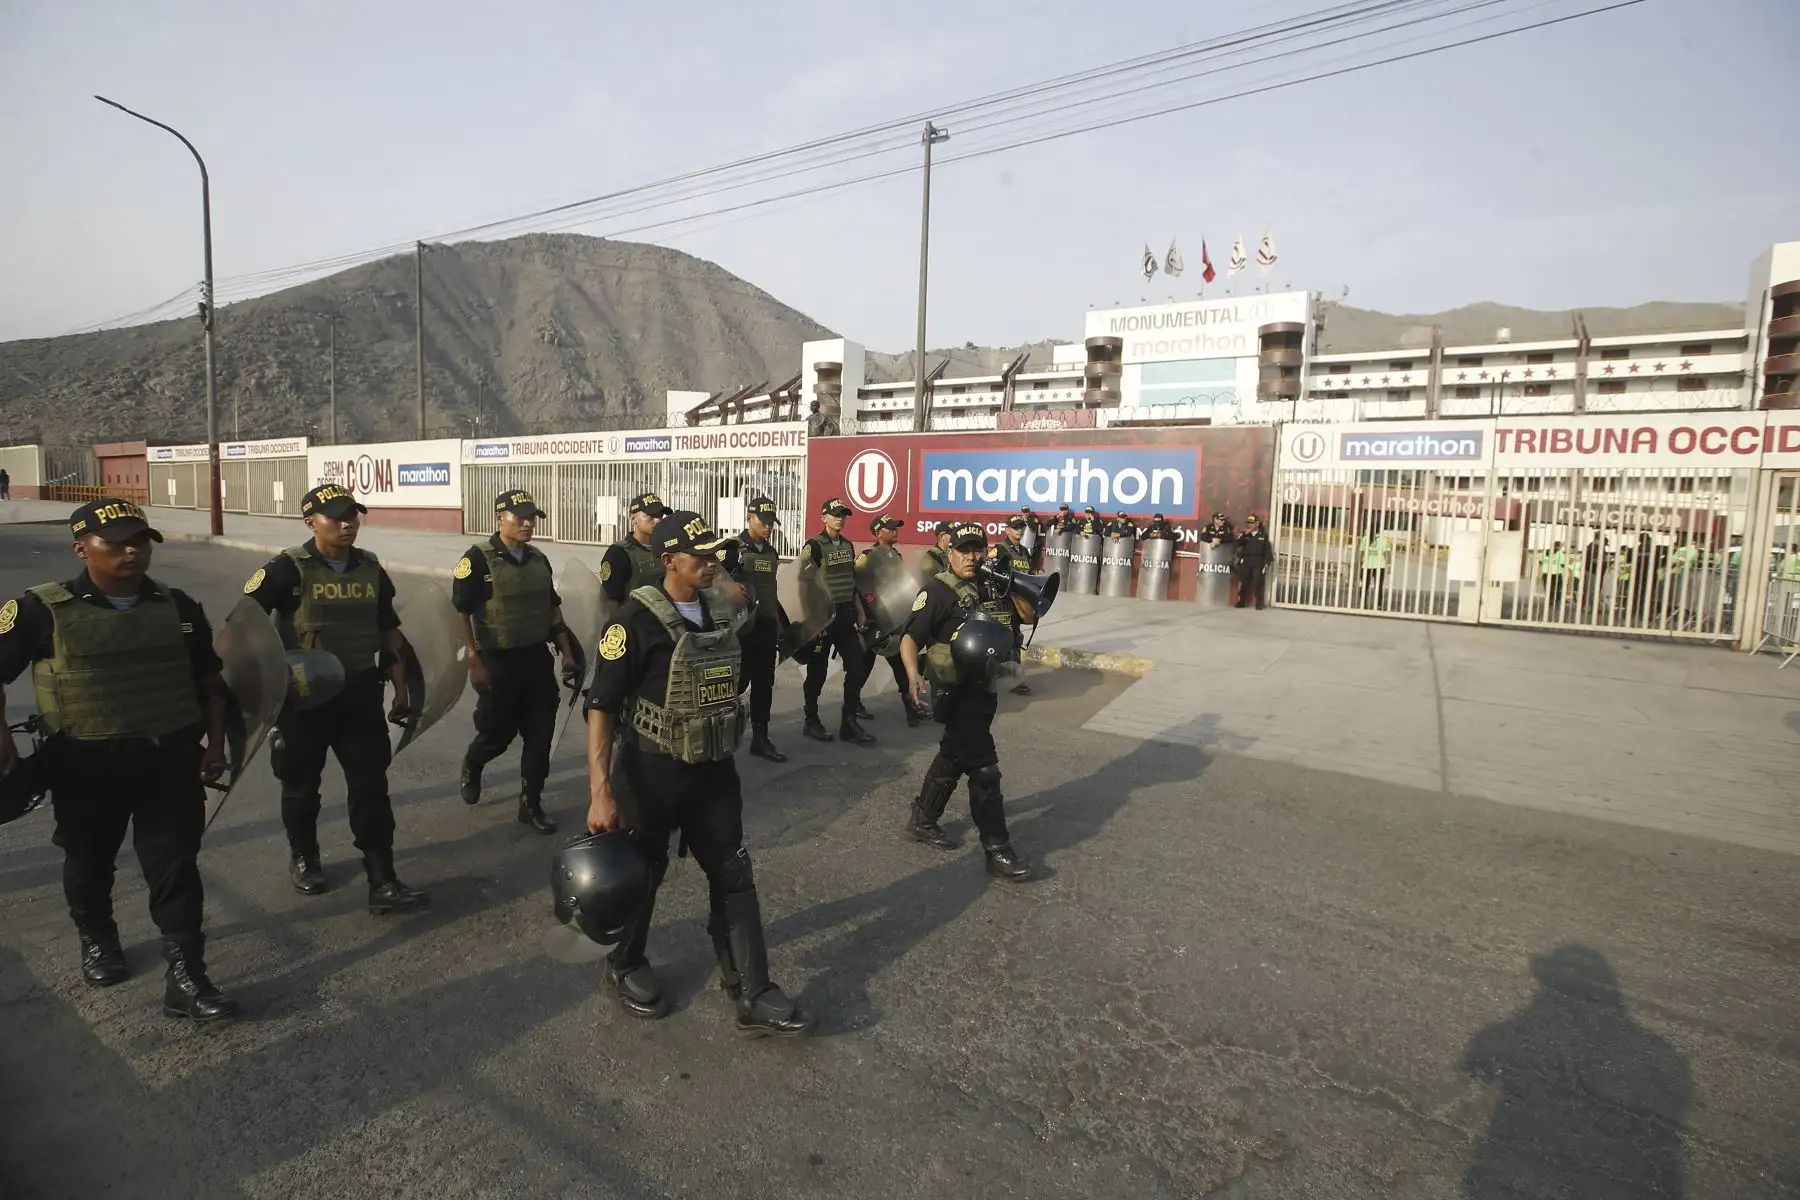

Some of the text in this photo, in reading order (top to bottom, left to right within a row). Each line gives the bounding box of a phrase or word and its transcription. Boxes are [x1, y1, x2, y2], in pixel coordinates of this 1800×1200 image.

[1110, 306, 1244, 333] MONUMENTAL
[1132, 331, 1246, 357] marathon
[248, 443, 270, 454] TRIBUNA
[270, 442, 300, 454] OCCIDENTE
[476, 445, 509, 456] marathon
[512, 441, 549, 455] TRIBUNA
[551, 440, 604, 454] OCCIDENTE
[626, 438, 670, 452] marathon
[675, 433, 727, 450] TRIBUNA
[730, 430, 806, 448] OCCIDENTE
[1345, 435, 1476, 456] marathon
[1495, 426, 1658, 454] TRIBUNA
[324, 461, 344, 477] CREMA
[399, 466, 449, 483] marathon
[858, 458, 1185, 506] U marathon
[956, 526, 983, 539] POLICIA
[1046, 547, 1070, 558] POLICIA
[1070, 554, 1098, 565] POLICIA
[1102, 557, 1131, 567] POLICIA
[1199, 563, 1231, 574] POLICIA
[700, 681, 735, 704] POLICIA
